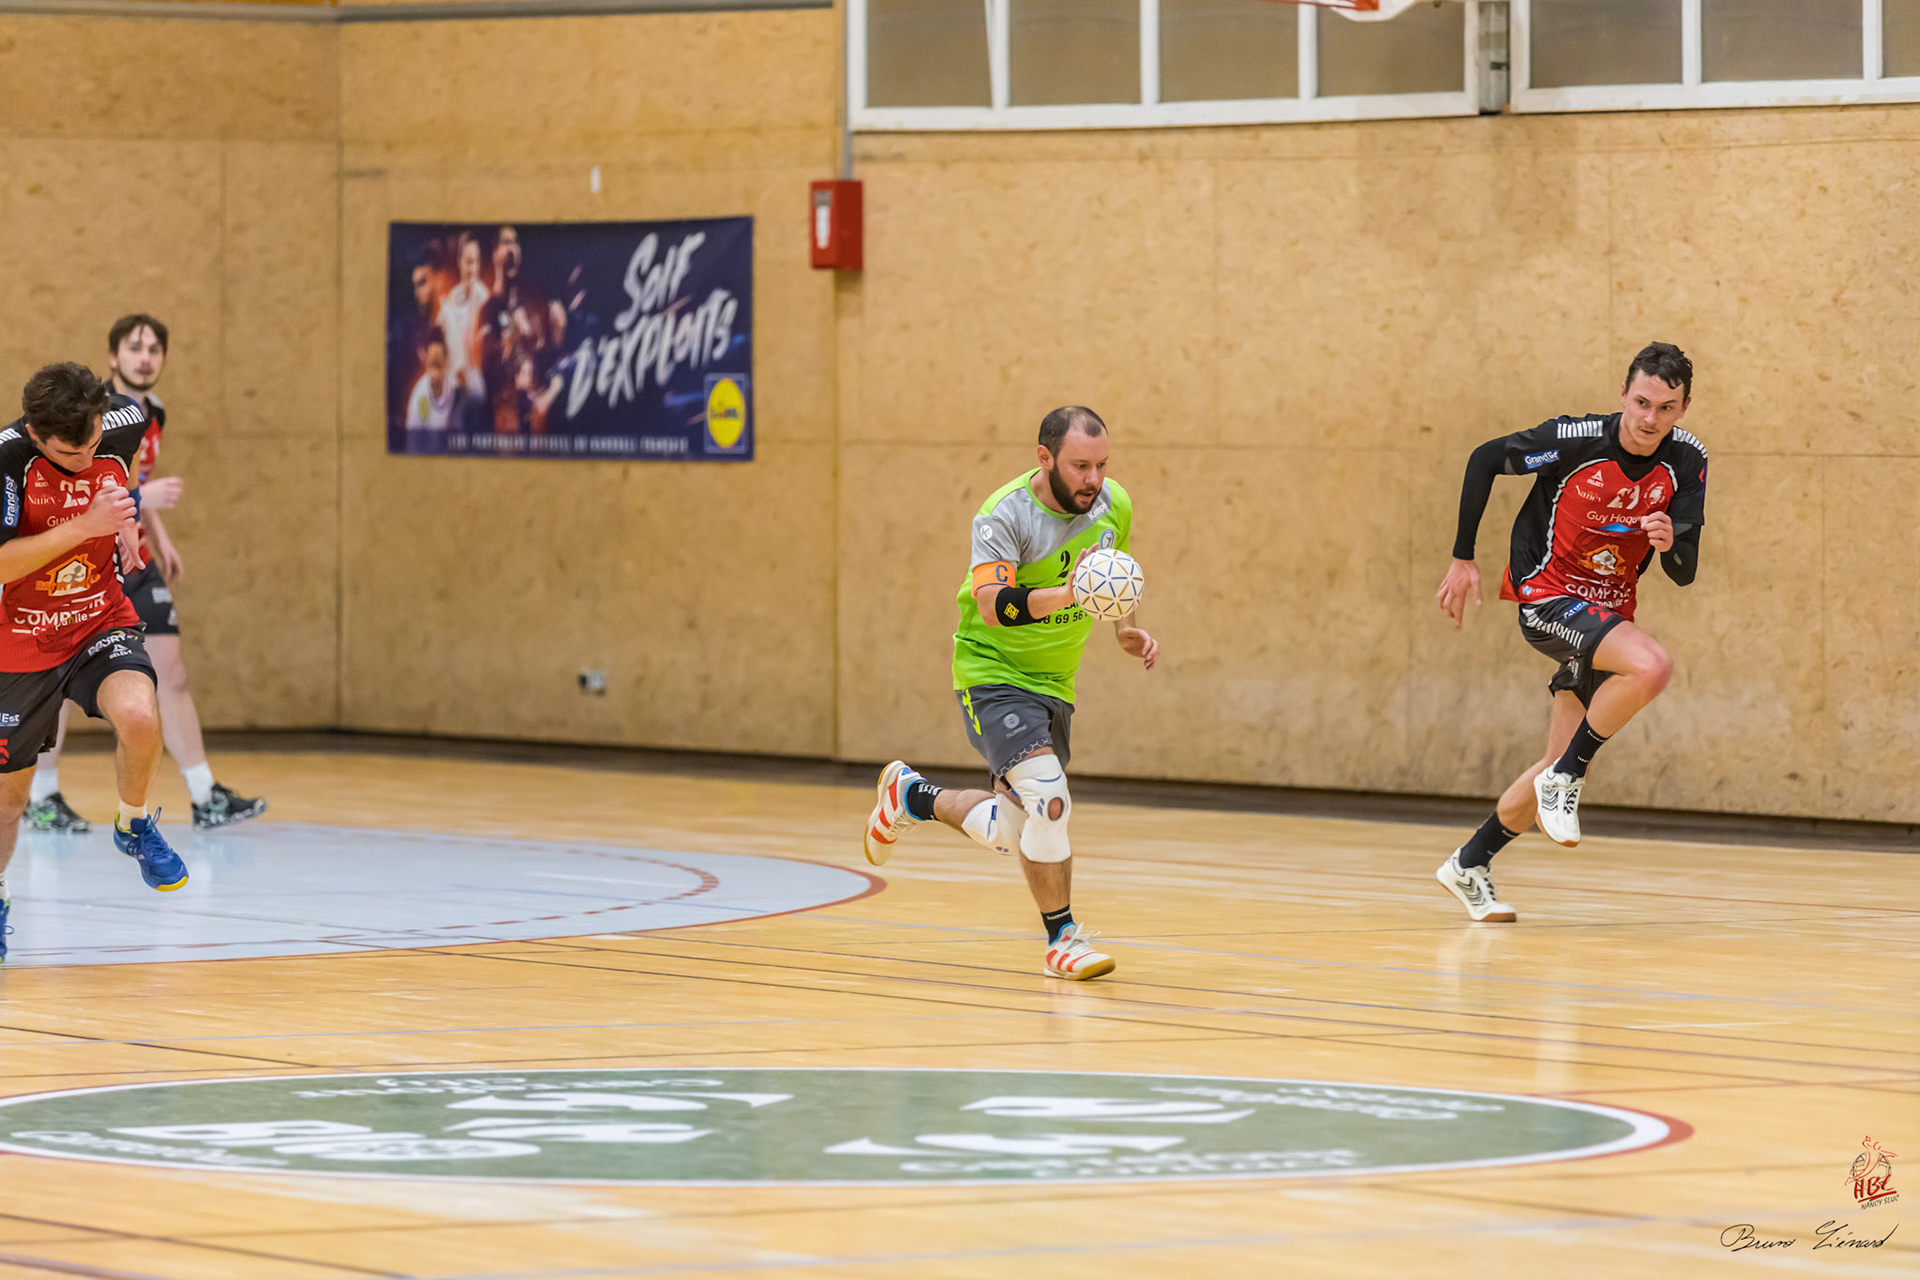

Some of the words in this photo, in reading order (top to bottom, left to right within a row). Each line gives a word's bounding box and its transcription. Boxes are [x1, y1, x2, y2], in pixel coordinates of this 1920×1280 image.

[60, 480, 91, 508] 25
[1586, 511, 1608, 524] Guy
[995, 564, 1008, 583] C
[1057, 550, 1071, 579] 2
[1055, 613, 1070, 624] 69
[1072, 610, 1083, 622] 56
